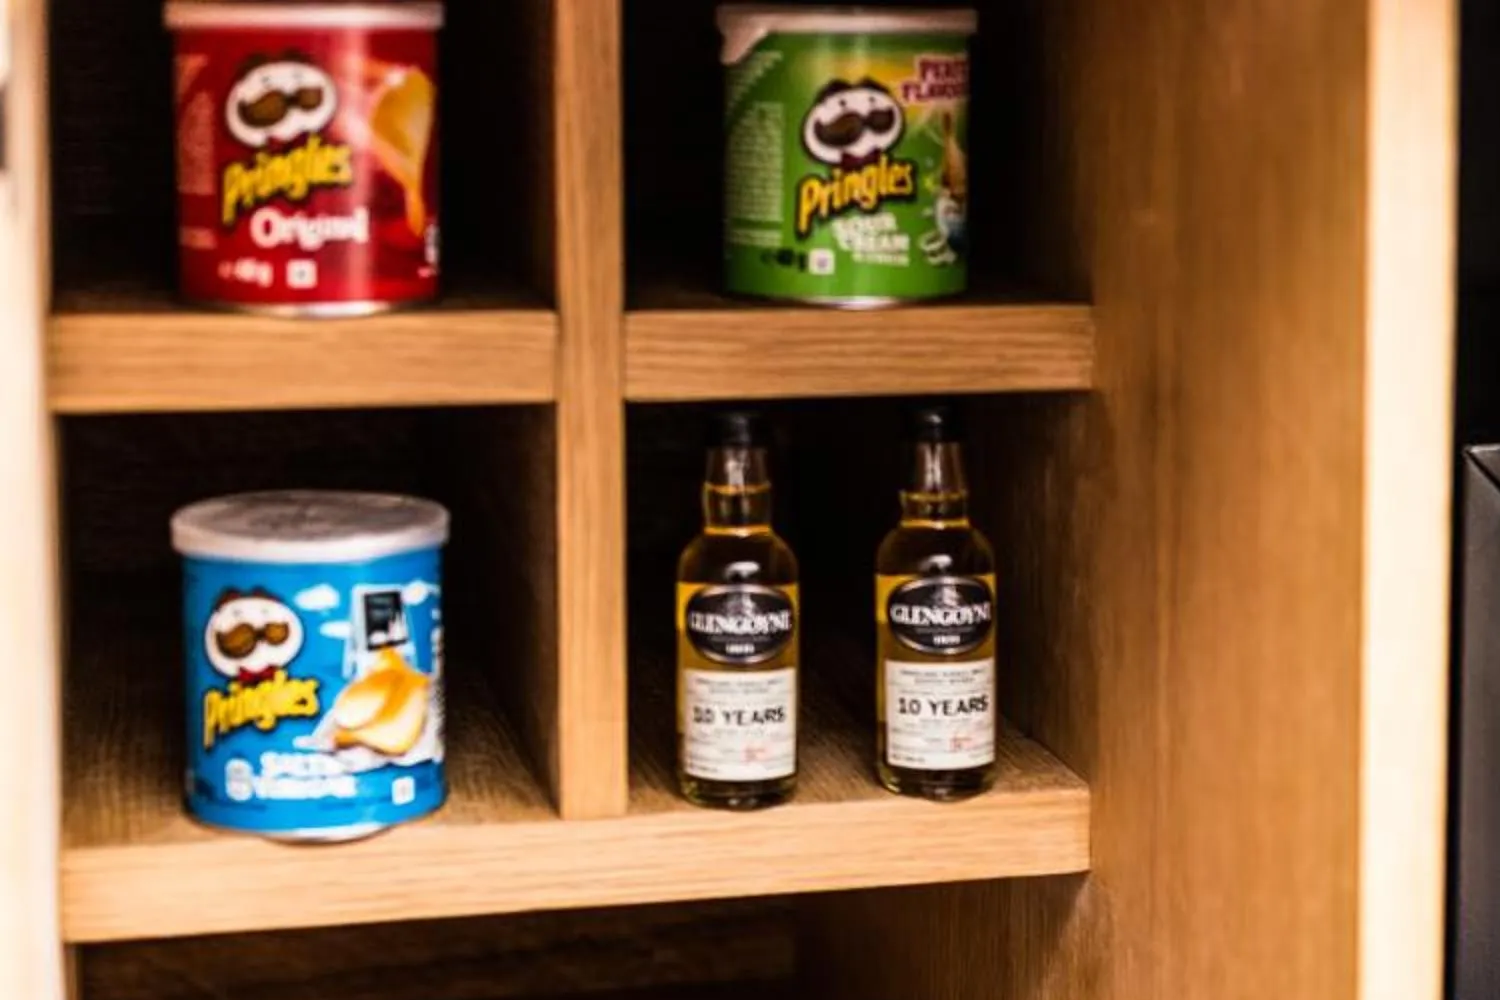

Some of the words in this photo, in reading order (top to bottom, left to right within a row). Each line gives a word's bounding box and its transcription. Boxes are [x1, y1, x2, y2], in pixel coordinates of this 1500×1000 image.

[221, 132, 353, 225] Pringles
[797, 152, 914, 235] Pringles
[249, 204, 369, 251] Original
[203, 668, 320, 749] Pringles
[722, 704, 787, 727] YEARS
[898, 697, 921, 716] 10
[927, 693, 990, 717] YEARS
